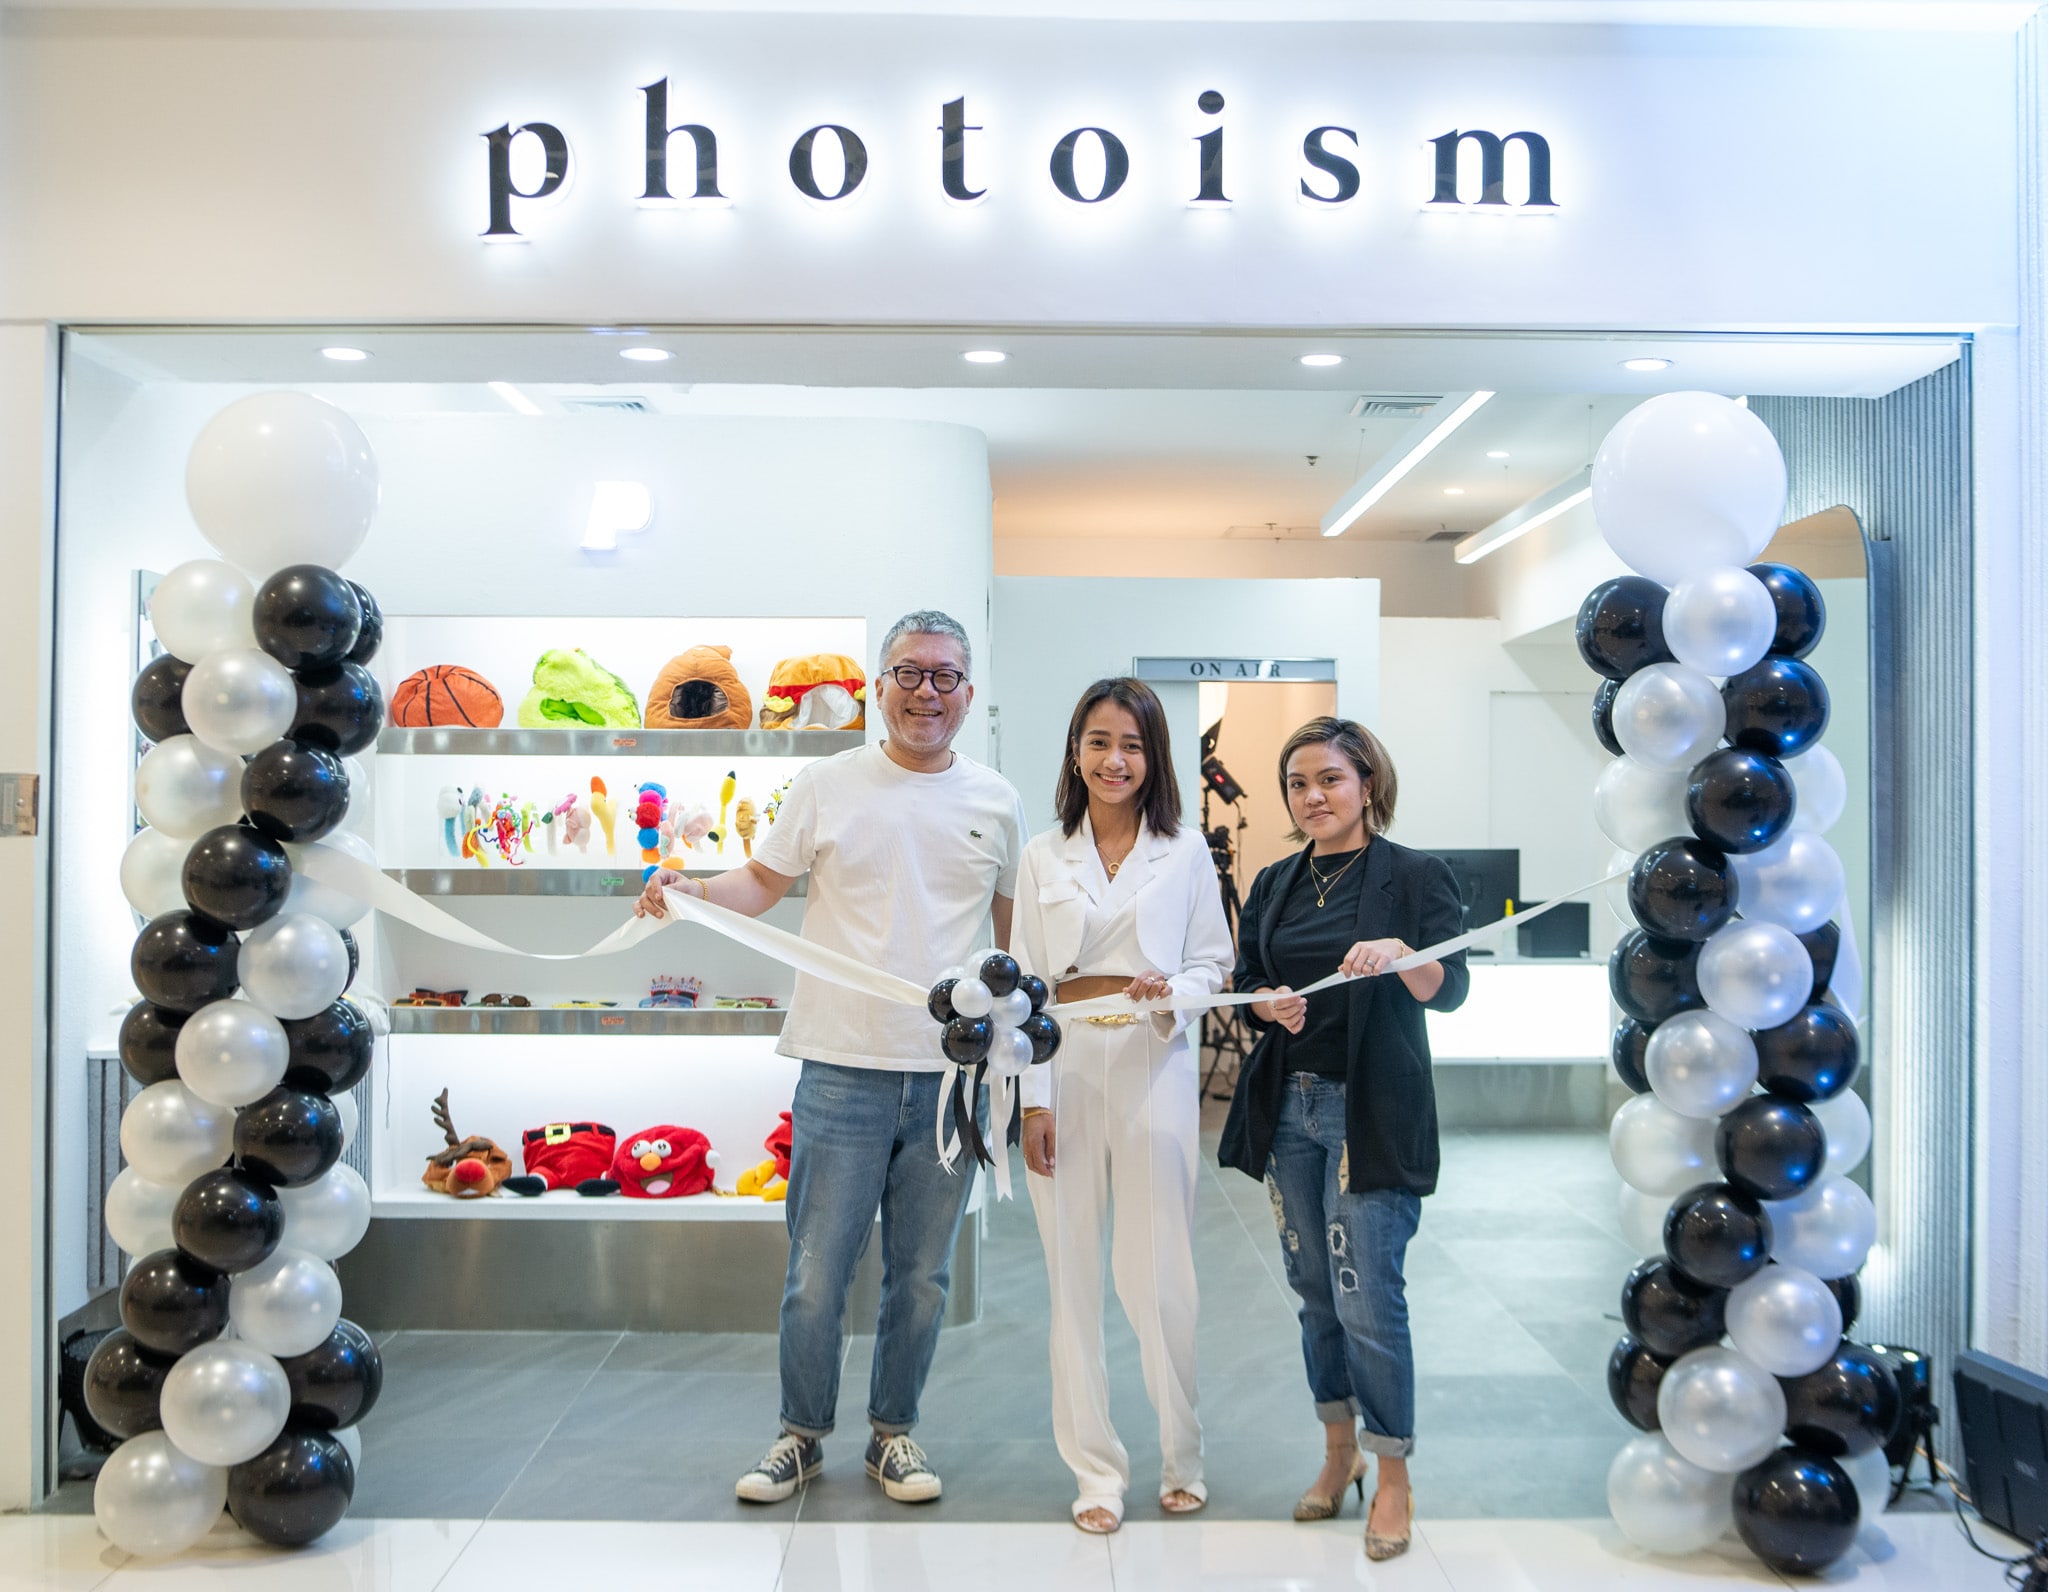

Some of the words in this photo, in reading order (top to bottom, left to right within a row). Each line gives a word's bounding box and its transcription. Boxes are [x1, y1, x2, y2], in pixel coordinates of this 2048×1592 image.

[477, 75, 1561, 237] photoism
[1190, 662, 1222, 676] ON
[1235, 663, 1281, 678] AIR
